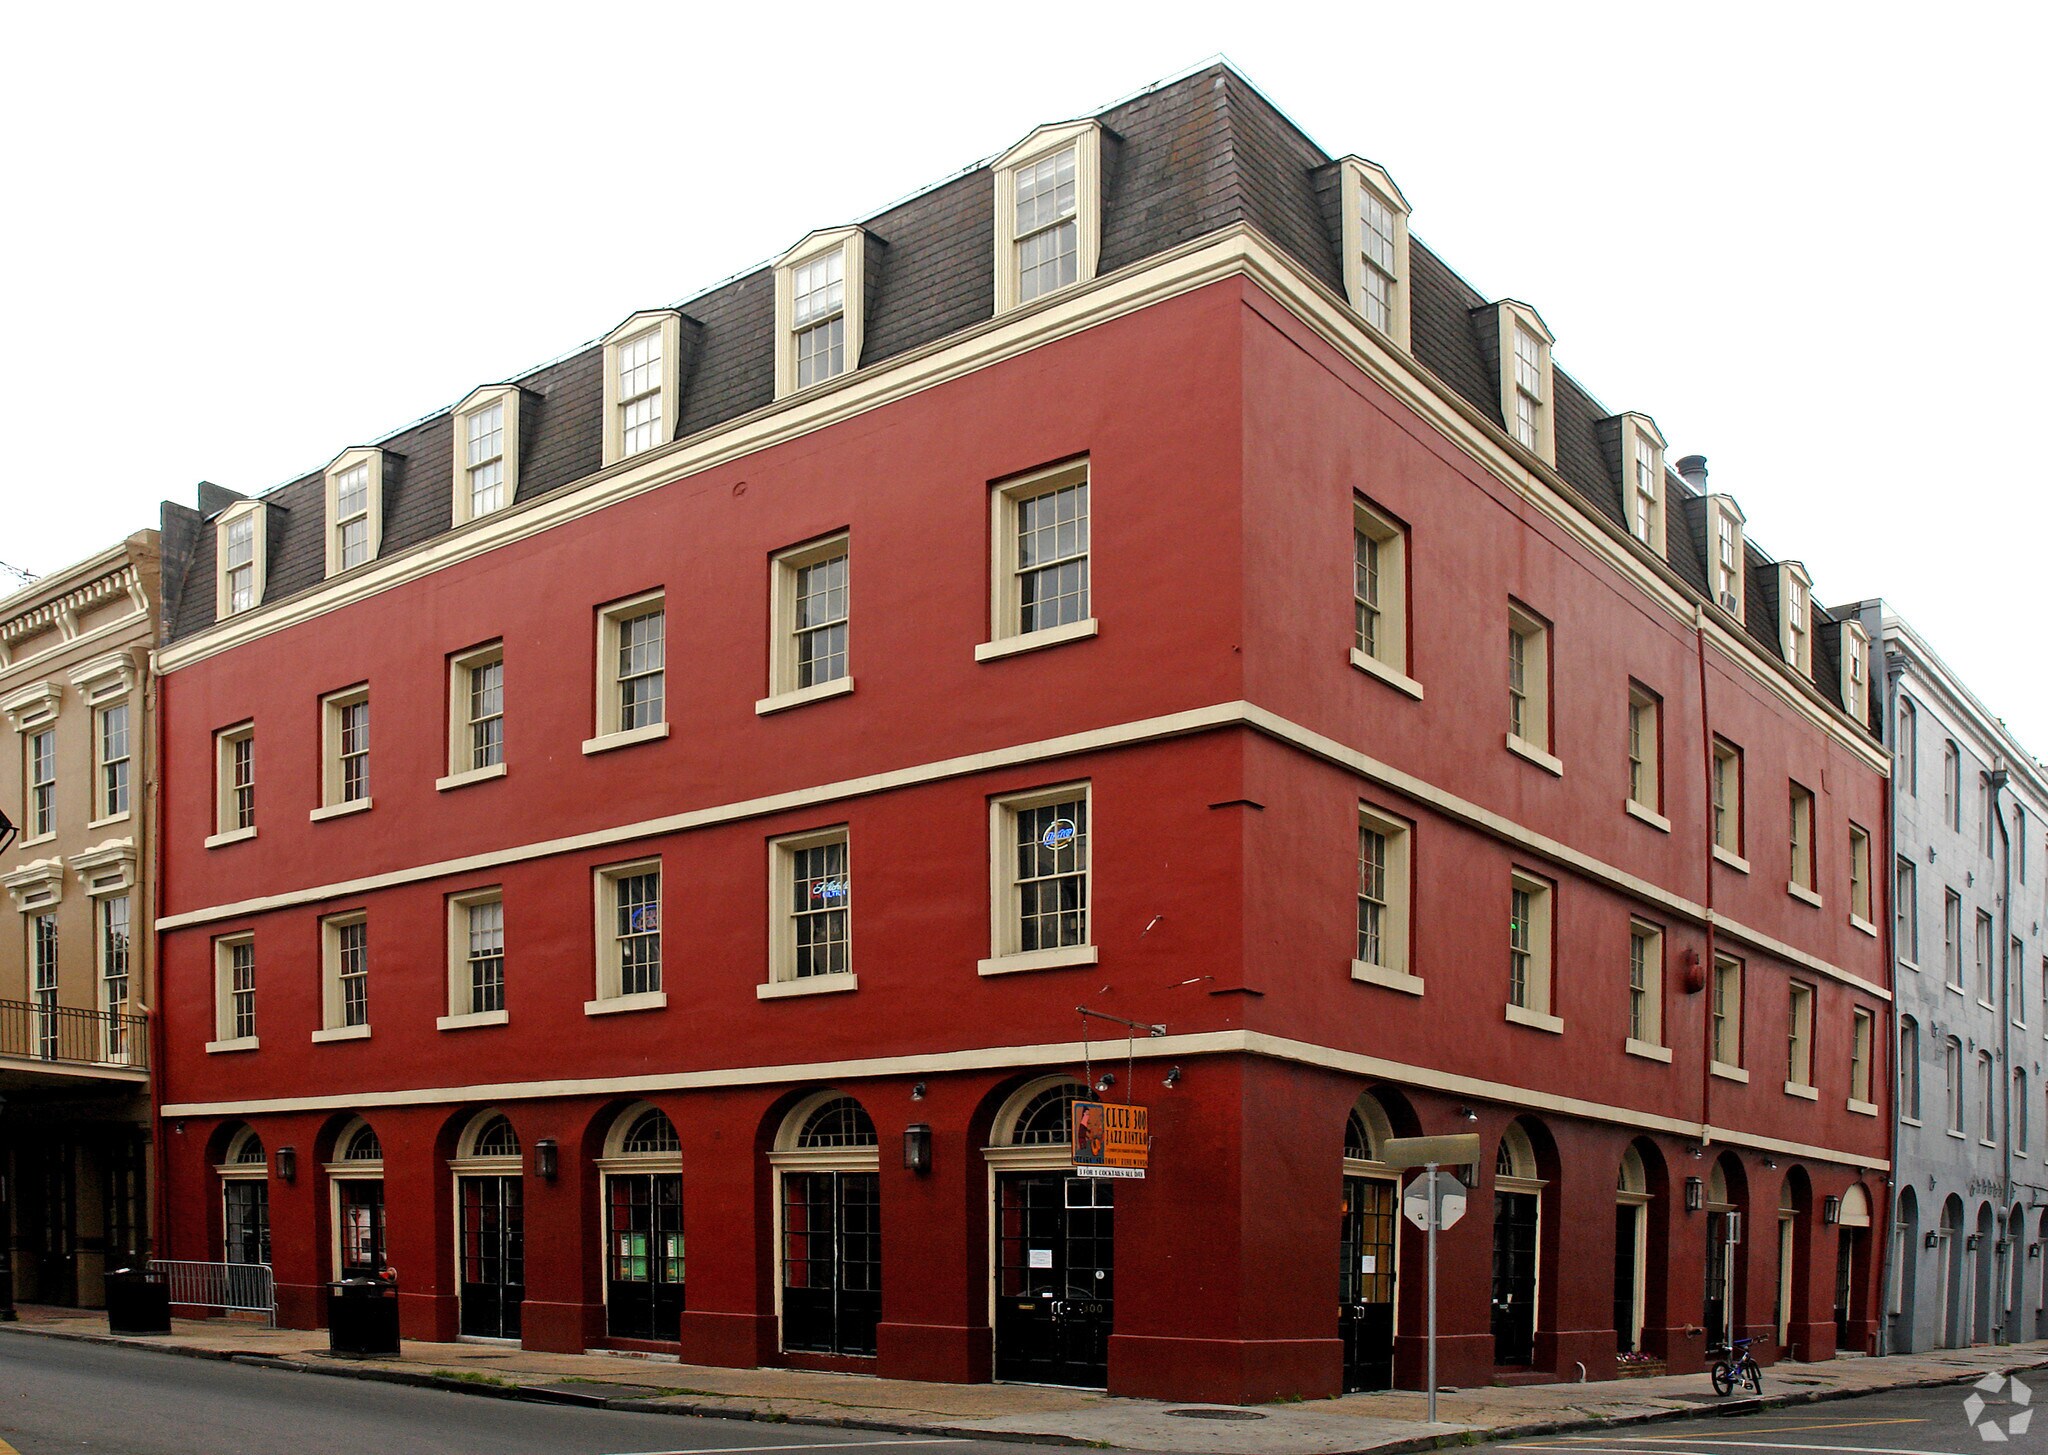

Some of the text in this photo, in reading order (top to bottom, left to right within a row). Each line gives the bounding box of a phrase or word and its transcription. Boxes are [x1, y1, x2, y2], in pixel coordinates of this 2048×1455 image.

[1106, 1107, 1147, 1130] CLUB 300
[1106, 1130, 1122, 1145] JAZZ
